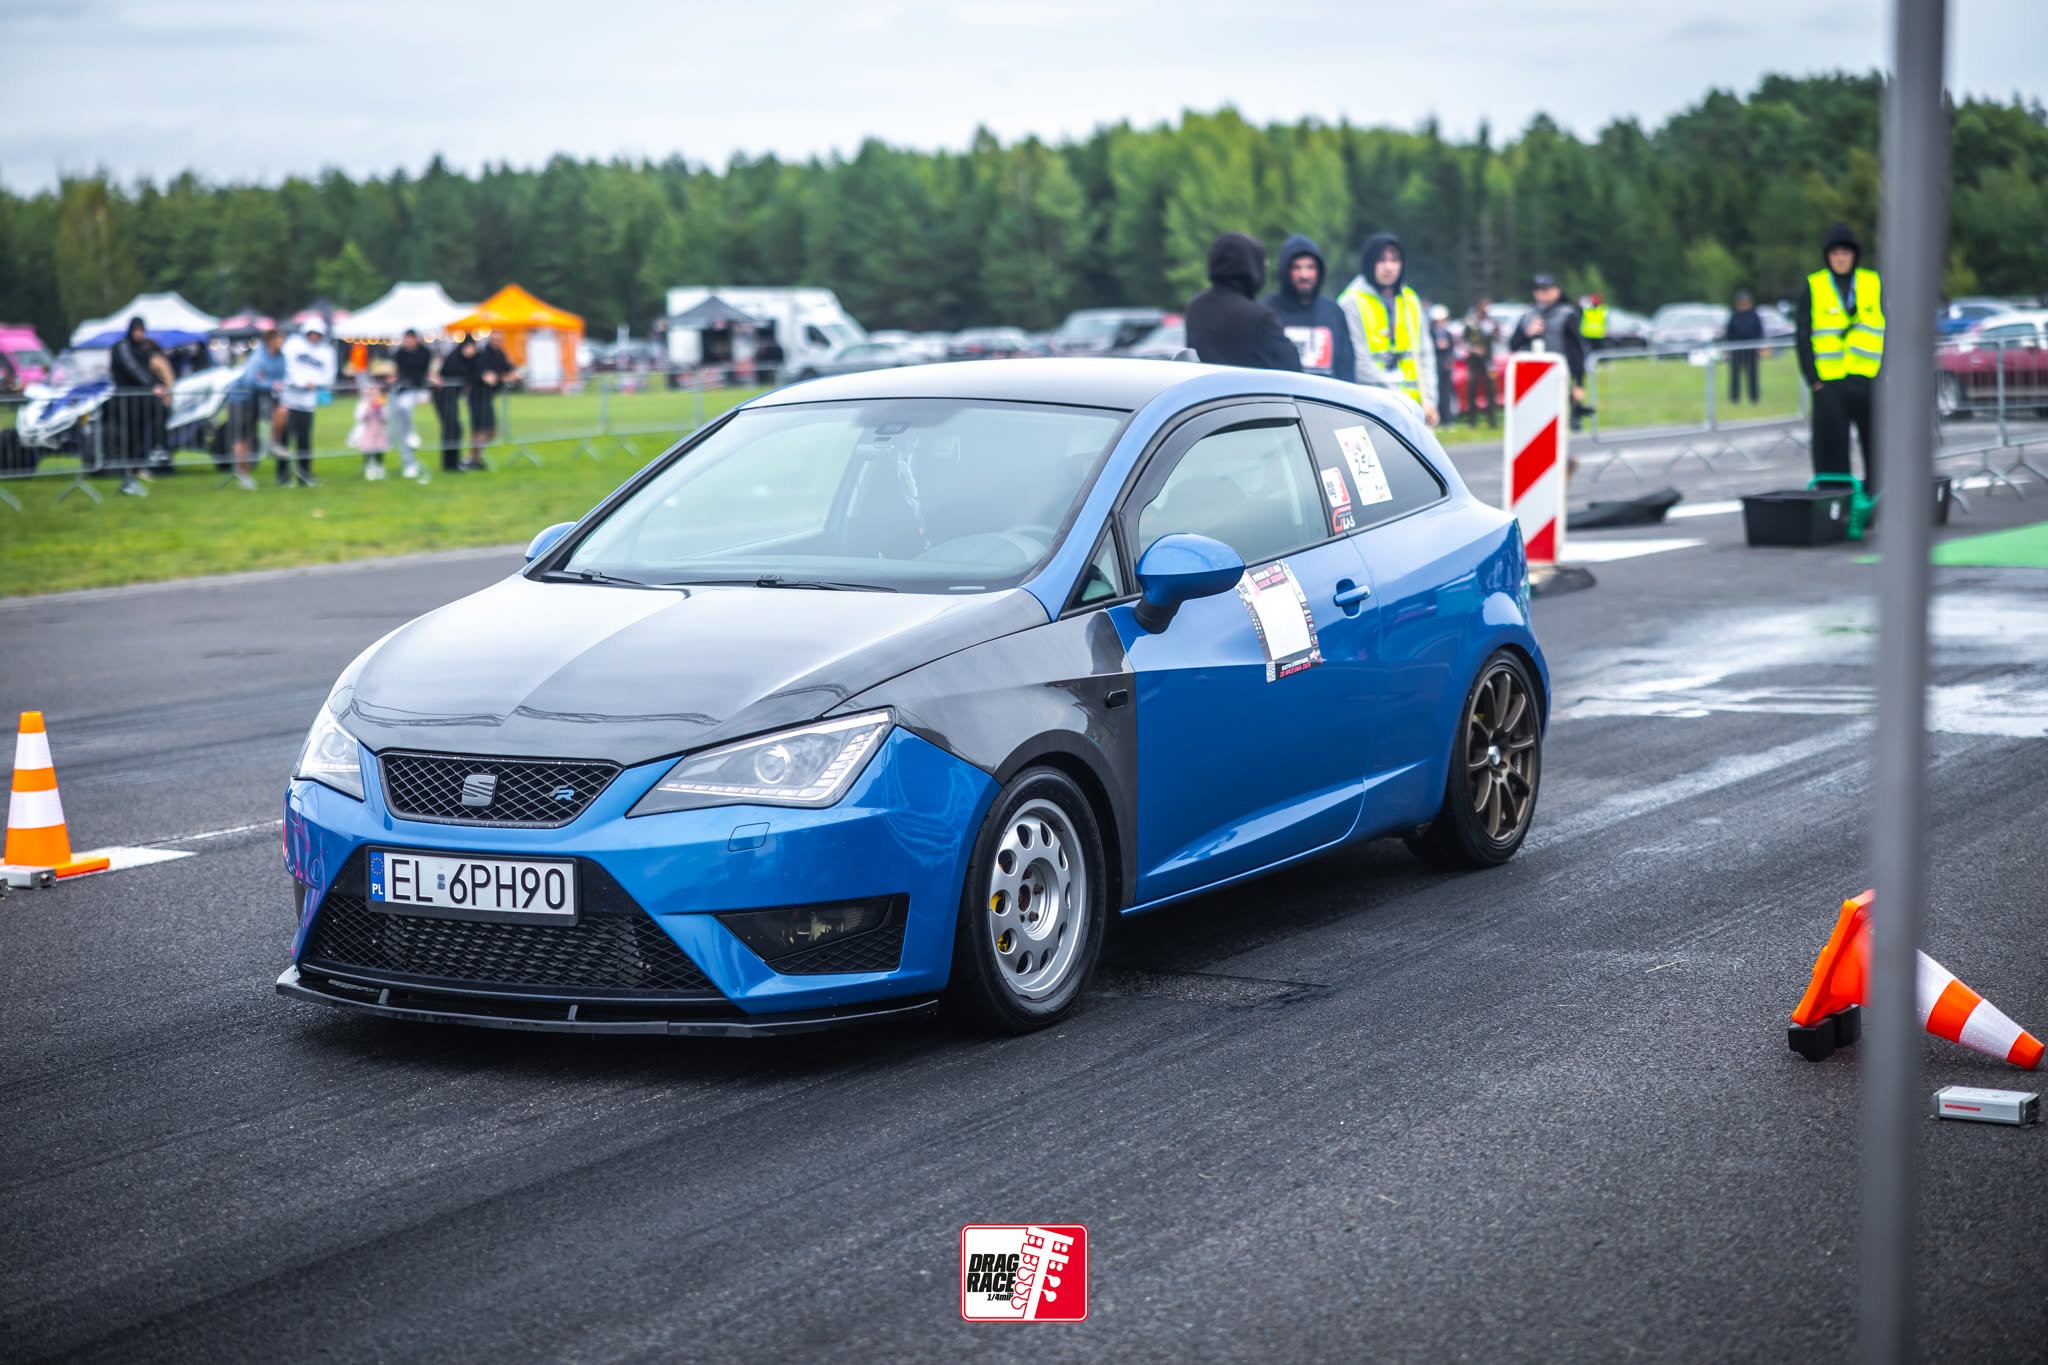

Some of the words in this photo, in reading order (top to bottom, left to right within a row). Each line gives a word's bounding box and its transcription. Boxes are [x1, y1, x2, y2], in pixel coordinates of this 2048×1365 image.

[372, 882, 384, 895] PL
[391, 858, 433, 903] EL
[449, 863, 566, 910] 6PH90
